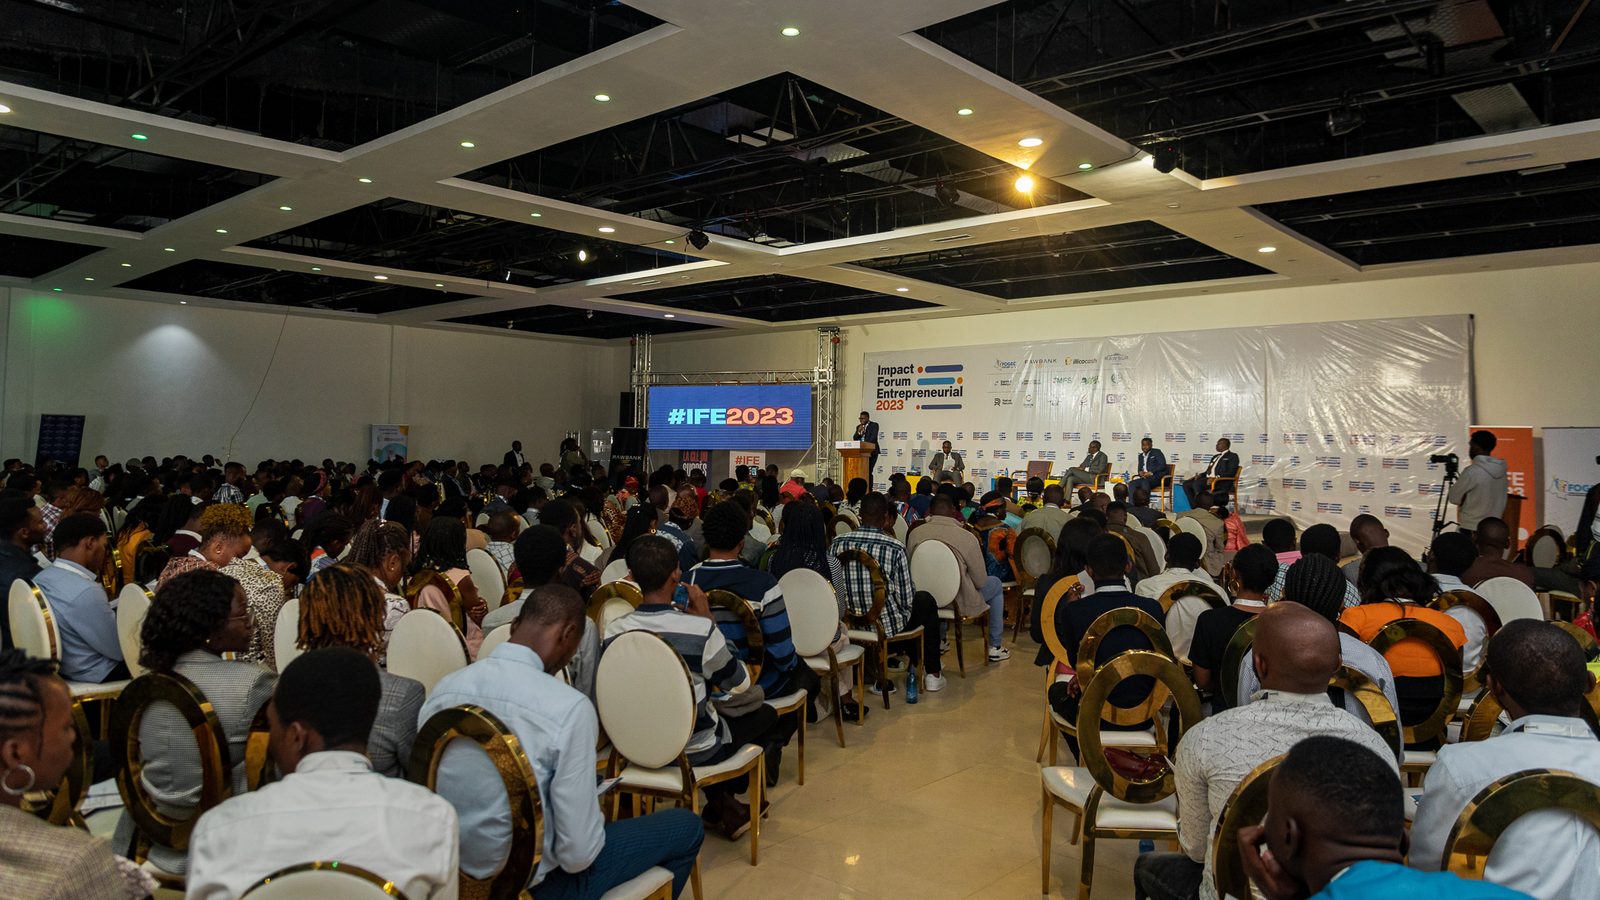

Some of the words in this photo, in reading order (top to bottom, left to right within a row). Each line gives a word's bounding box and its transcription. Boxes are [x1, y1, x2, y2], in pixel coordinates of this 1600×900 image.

[877, 364, 915, 378] Impact
[877, 377, 911, 388] Forum
[876, 386, 964, 401] Entrepreneurial
[876, 400, 905, 411] 2023
[667, 407, 795, 426] #IFE2023
[735, 455, 761, 465] #IFE
